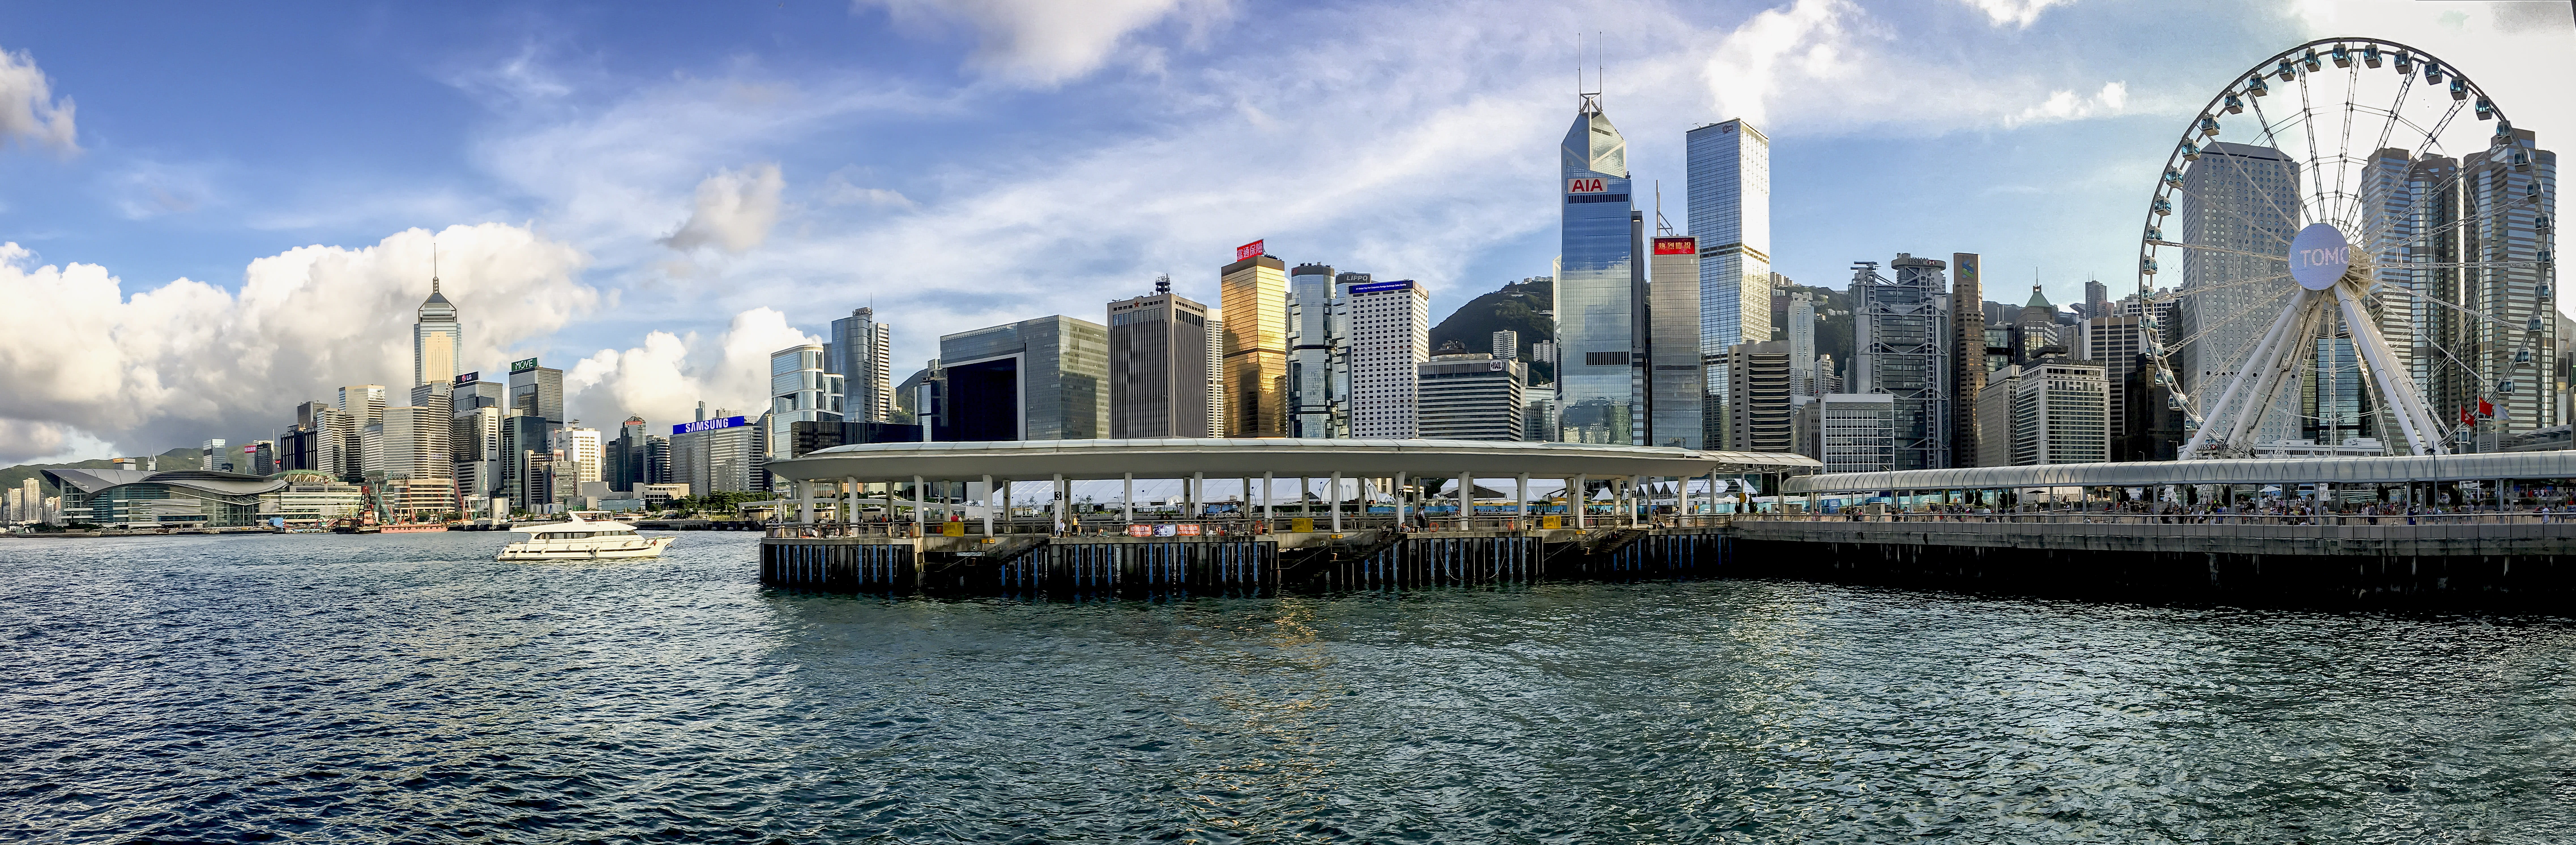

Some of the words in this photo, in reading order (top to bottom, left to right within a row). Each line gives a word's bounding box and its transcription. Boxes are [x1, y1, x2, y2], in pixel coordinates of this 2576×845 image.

[1572, 179, 1603, 192] AIA
[1237, 242, 1263, 260] 富通保險
[515, 359, 533, 370] MOVE
[685, 418, 728, 433] SAMSUNG
